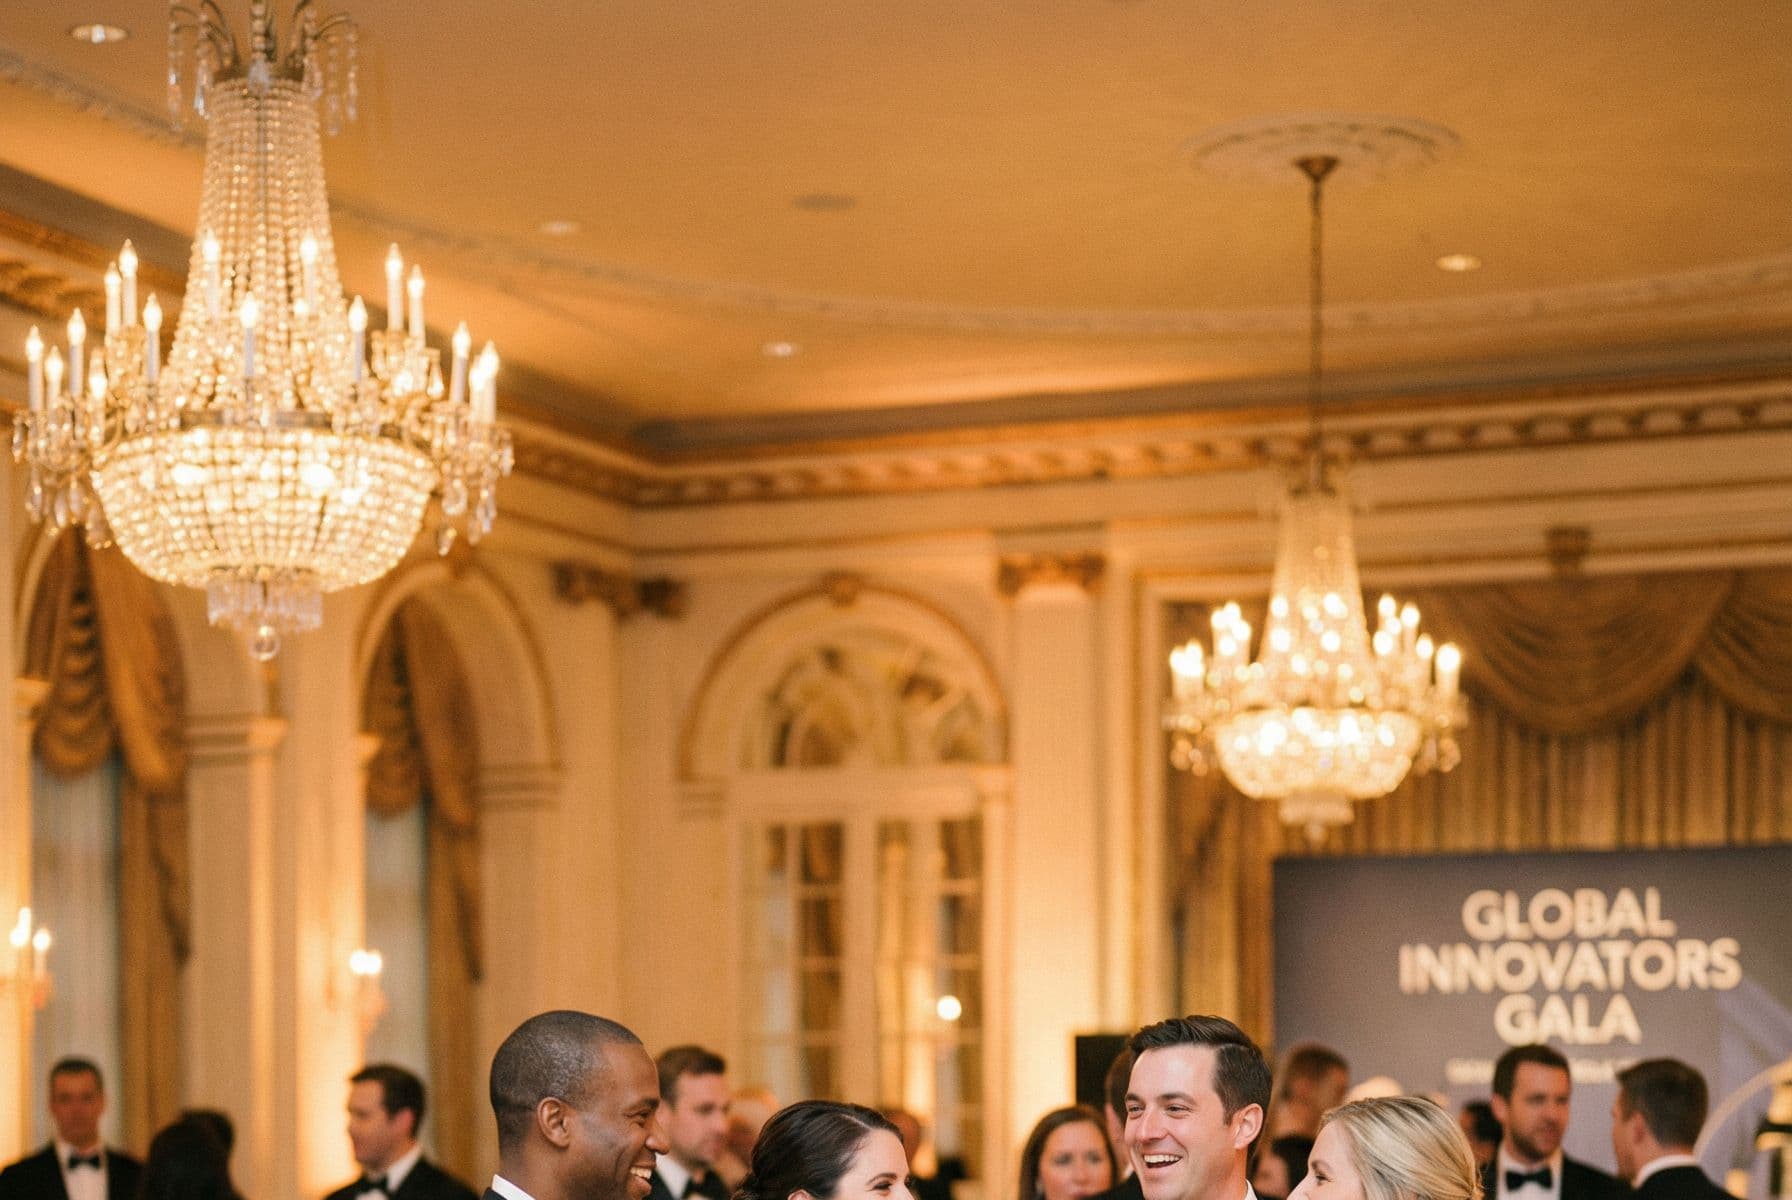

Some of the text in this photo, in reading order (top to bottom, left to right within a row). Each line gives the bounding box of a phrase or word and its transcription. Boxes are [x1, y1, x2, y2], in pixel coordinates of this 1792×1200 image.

[1462, 888, 1676, 939] GLOBAL
[1400, 938, 1743, 994] INNOVATORS
[1494, 994, 1643, 1045] GALA
